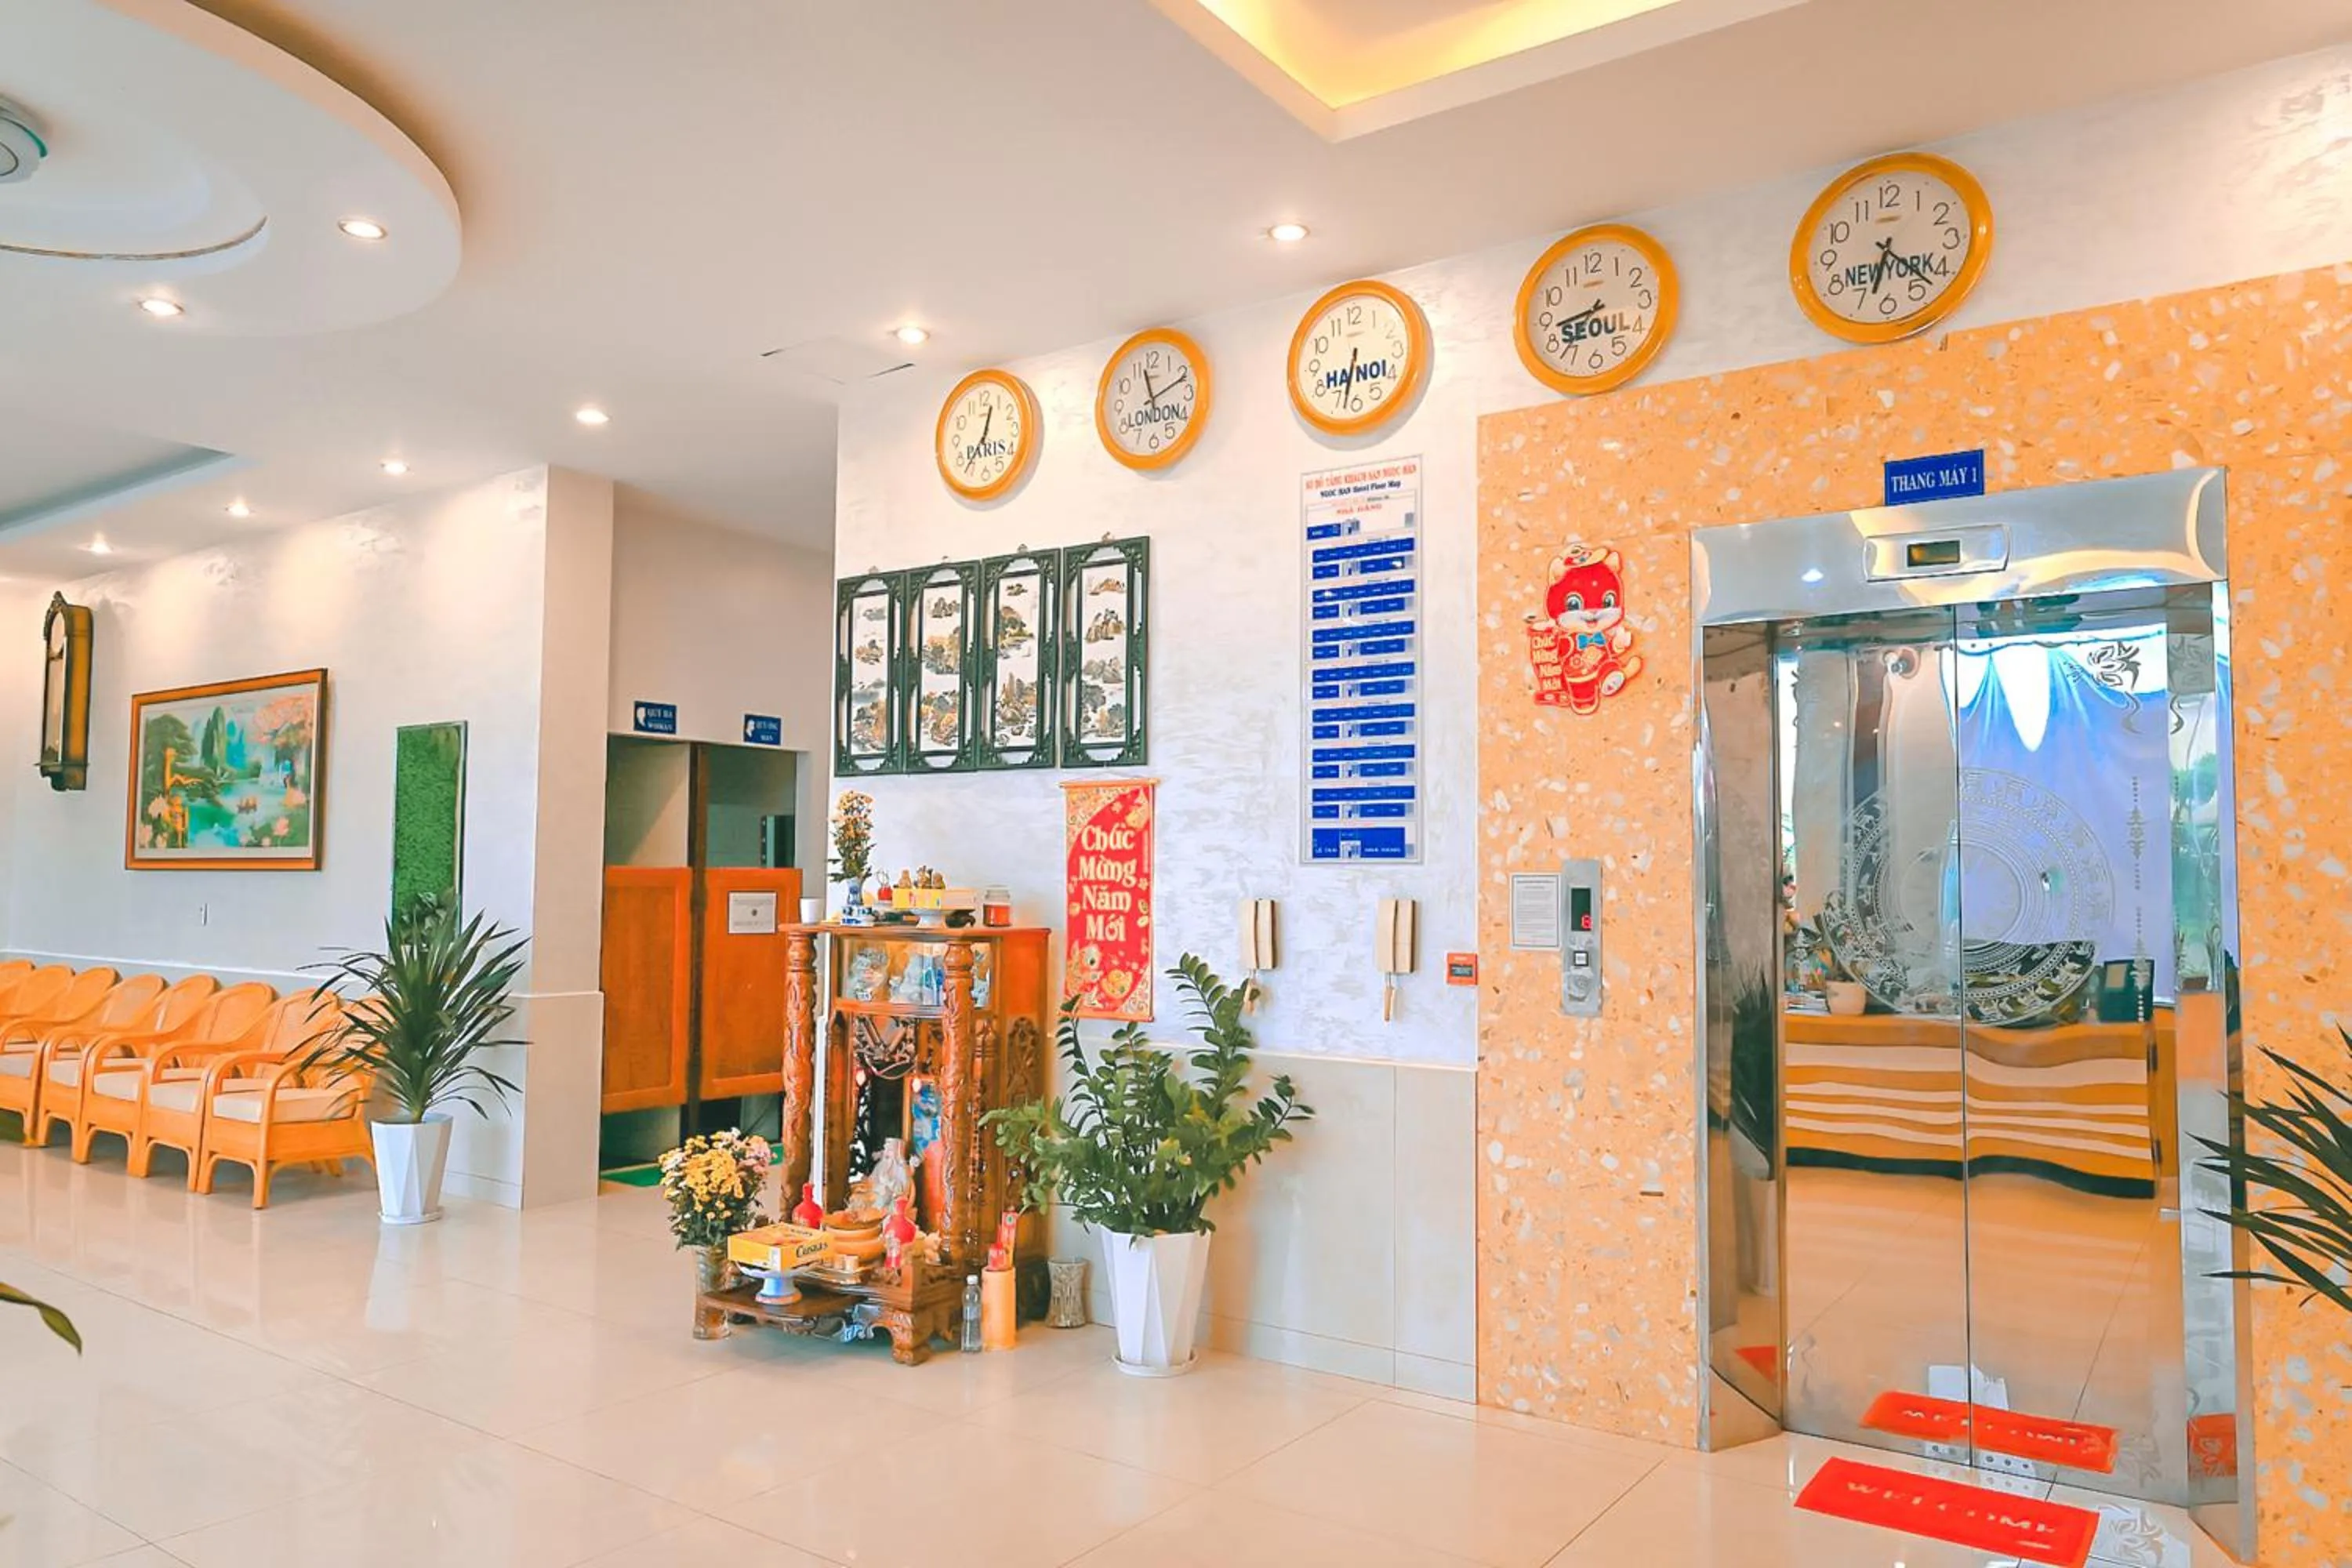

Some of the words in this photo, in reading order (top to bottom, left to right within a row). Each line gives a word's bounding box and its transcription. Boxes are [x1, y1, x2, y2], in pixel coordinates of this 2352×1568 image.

[1879, 184, 1900, 209] 12
[1915, 190, 1920, 212] 1
[1856, 200, 1868, 223] 11
[1933, 202, 1950, 226] 2
[1830, 221, 1850, 245] 10
[1942, 227, 1961, 250] 3
[1584, 252, 1602, 274] 12
[1614, 256, 1619, 277] 1
[1820, 249, 1838, 271] 9
[1933, 255, 1950, 277] 4
[1566, 266, 1577, 289] 11
[1628, 267, 1642, 289] 2
[1828, 274, 1845, 296] 8
[1545, 286, 1563, 308] 10
[1637, 289, 1653, 310] 3
[1852, 288, 1867, 310] 7
[1907, 278, 1926, 301] 5
[1879, 292, 1897, 314] 6
[1346, 306, 1362, 325] 12
[1539, 311, 1553, 332] 9
[1632, 315, 1646, 335] 4
[1331, 318, 1341, 337] 11
[1561, 311, 1631, 343] SEOUL
[1314, 336, 1329, 354] 10
[1392, 339, 1404, 359] 3
[1545, 333, 1559, 353] 8
[1611, 336, 1627, 357] 5
[1146, 350, 1160, 369] 12
[1308, 358, 1321, 376] 9
[1588, 349, 1603, 369] 6
[1133, 361, 1142, 380] 11
[1386, 364, 1397, 382] 4
[1119, 377, 1131, 394] 10
[1183, 384, 1194, 401] 3
[1315, 379, 1327, 397] 8
[1369, 382, 1382, 401] 5
[968, 401, 975, 416] 11
[979, 390, 990, 407] 12
[1114, 399, 1124, 416] 9
[1331, 390, 1342, 409] 7
[1350, 394, 1363, 412] 6
[1005, 403, 1014, 421] 2
[1128, 403, 1180, 427] LONDON
[956, 415, 967, 430] 10
[1011, 422, 1019, 437] 3
[1119, 417, 1129, 434] 8
[1164, 421, 1175, 439] 5
[952, 434, 961, 449] 9
[1133, 428, 1142, 445] 7
[1149, 433, 1160, 449] 6
[967, 438, 1006, 459] PARIS
[1007, 441, 1015, 455] 4
[956, 451, 964, 466] 8
[995, 456, 1004, 473] 5
[981, 466, 991, 481] 6
[1891, 471, 1936, 492] THANG
[1939, 463, 1968, 487] MÁY
[1972, 467, 1976, 482] 1
[1081, 822, 1135, 852] Chúc
[1079, 855, 1137, 888] Mừng
[1082, 884, 1132, 913] Năm
[1086, 913, 1127, 942] Mới
